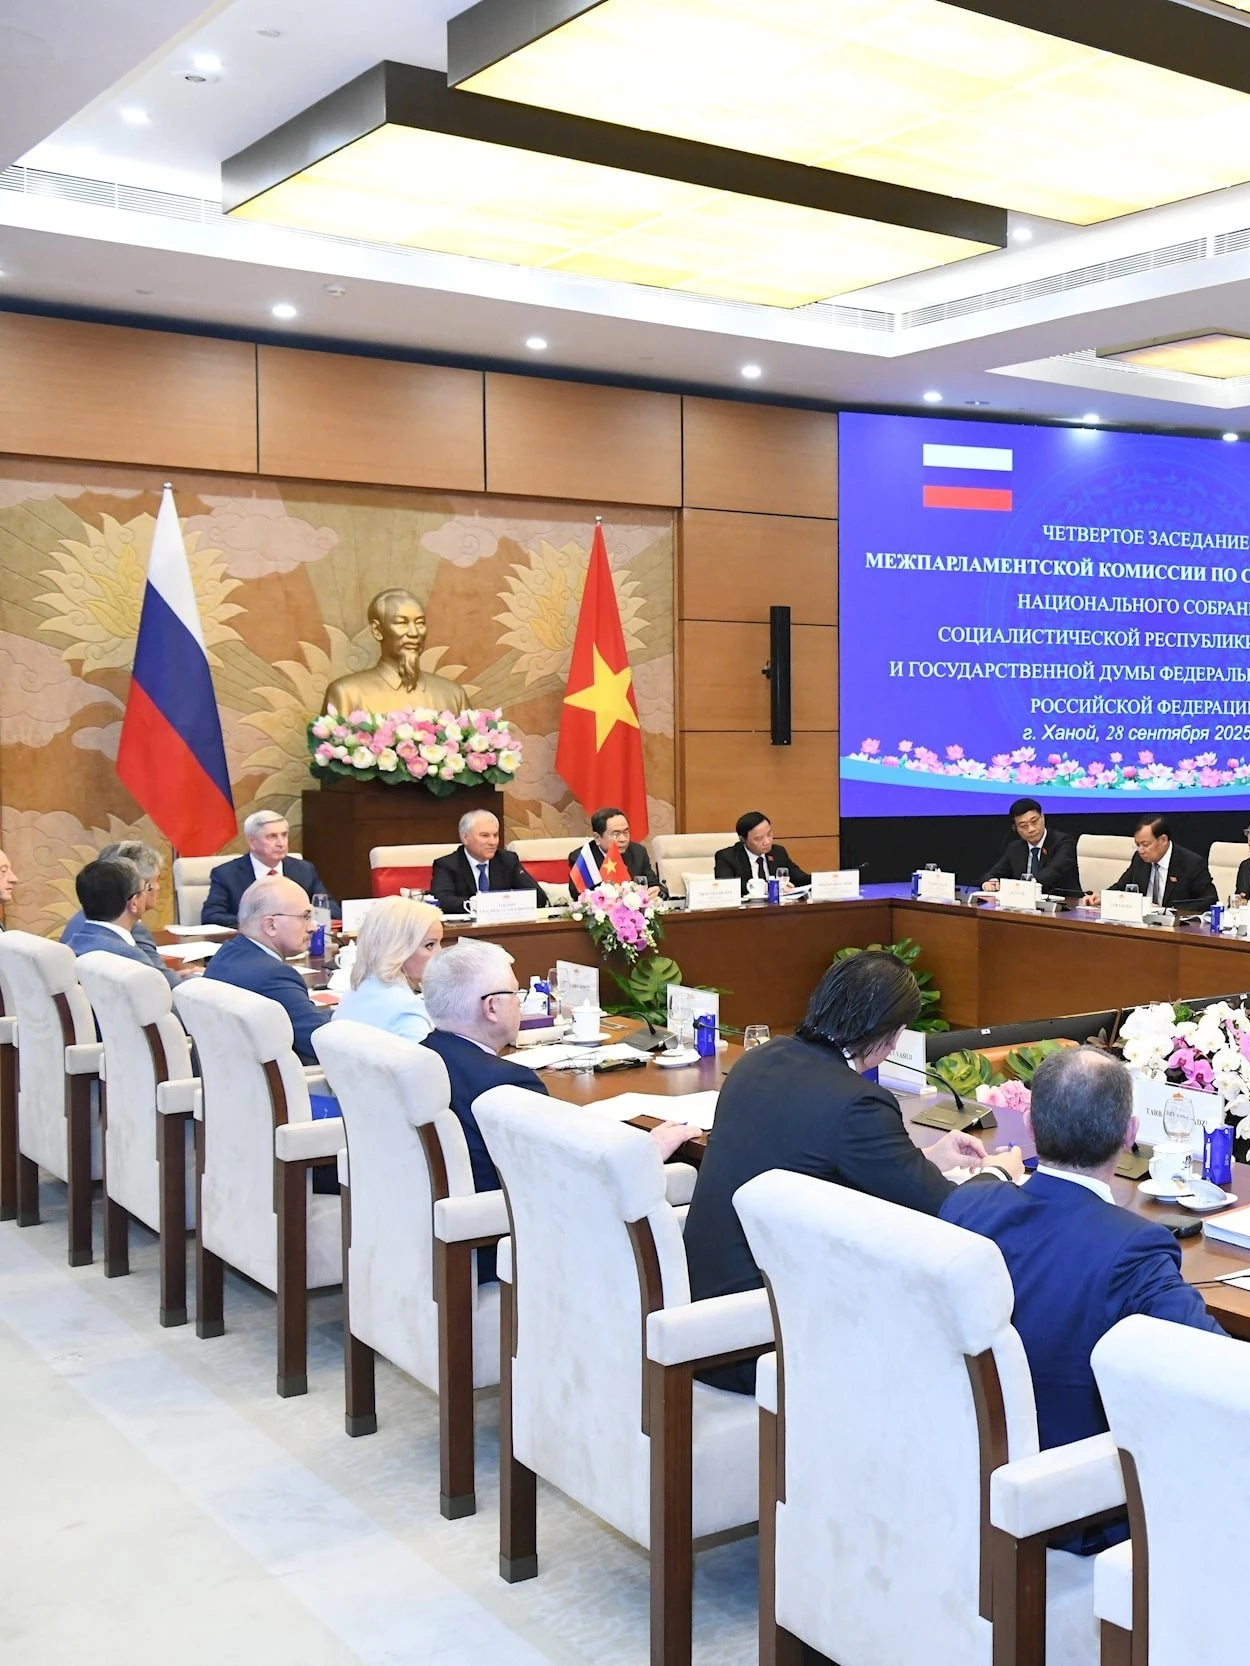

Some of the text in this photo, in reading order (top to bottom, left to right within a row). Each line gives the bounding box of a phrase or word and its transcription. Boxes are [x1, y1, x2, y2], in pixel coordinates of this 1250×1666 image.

[1042, 524, 1250, 551] ЧЕТВЕРТОЕ ЗАСЕДАНИЕ
[865, 551, 1094, 577] МЕЖПАРЛАМЕНТСКОЙ
[1098, 561, 1207, 582] КОМИССИИ
[1211, 566, 1238, 583] ПО
[1017, 593, 1180, 614] НАЦИОНАЛЬНОГО
[937, 626, 1141, 647] СОЦИАЛИСТИЧЕСКОЙ
[889, 660, 904, 677] И
[908, 660, 1096, 681] ГОСУДАРСТВЕННОЙ
[1098, 664, 1156, 683] ДУМЫ
[1030, 694, 1153, 715] РОССИЙСКОЙ
[1022, 727, 1037, 741] г.
[1041, 723, 1100, 743] Ханой,
[1105, 725, 1125, 741] 28
[1127, 724, 1210, 745] сентября
